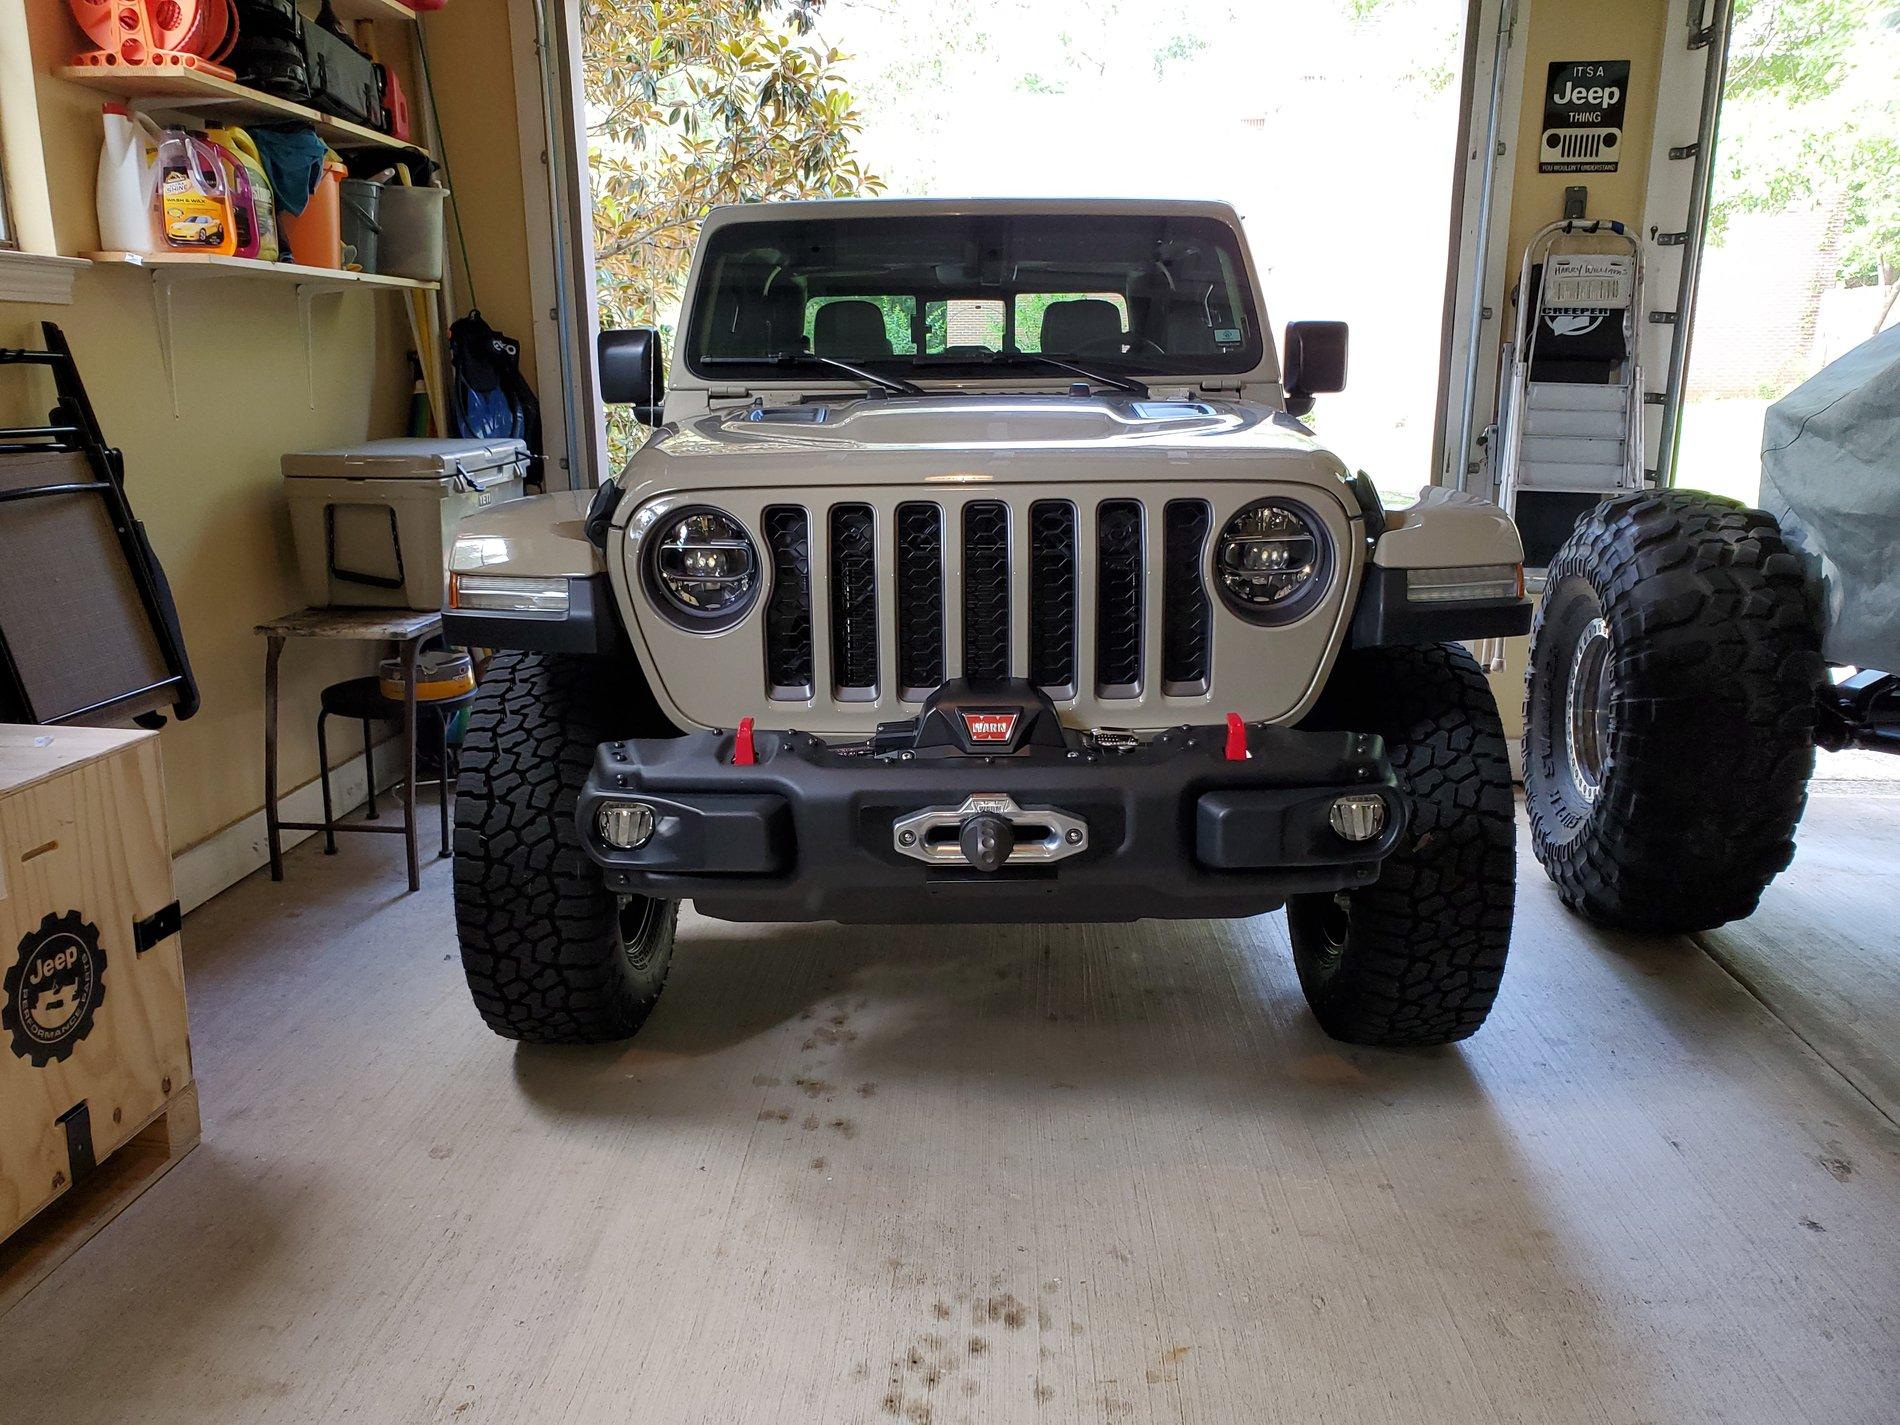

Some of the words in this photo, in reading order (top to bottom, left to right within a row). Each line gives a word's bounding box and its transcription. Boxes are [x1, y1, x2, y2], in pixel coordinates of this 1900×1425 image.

[1573, 66, 1594, 77] IT'S
[1596, 66, 1604, 77] A
[1553, 81, 1620, 109] Jeep
[1568, 111, 1601, 122] THING
[1542, 307, 1609, 315] CREEPER
[479, 492, 491, 506] YETI
[972, 722, 1007, 733] WARN
[30, 945, 78, 985] Jeep
[22, 988, 83, 1040] PERFORMANCE
[81, 952, 93, 1002] PARTS
